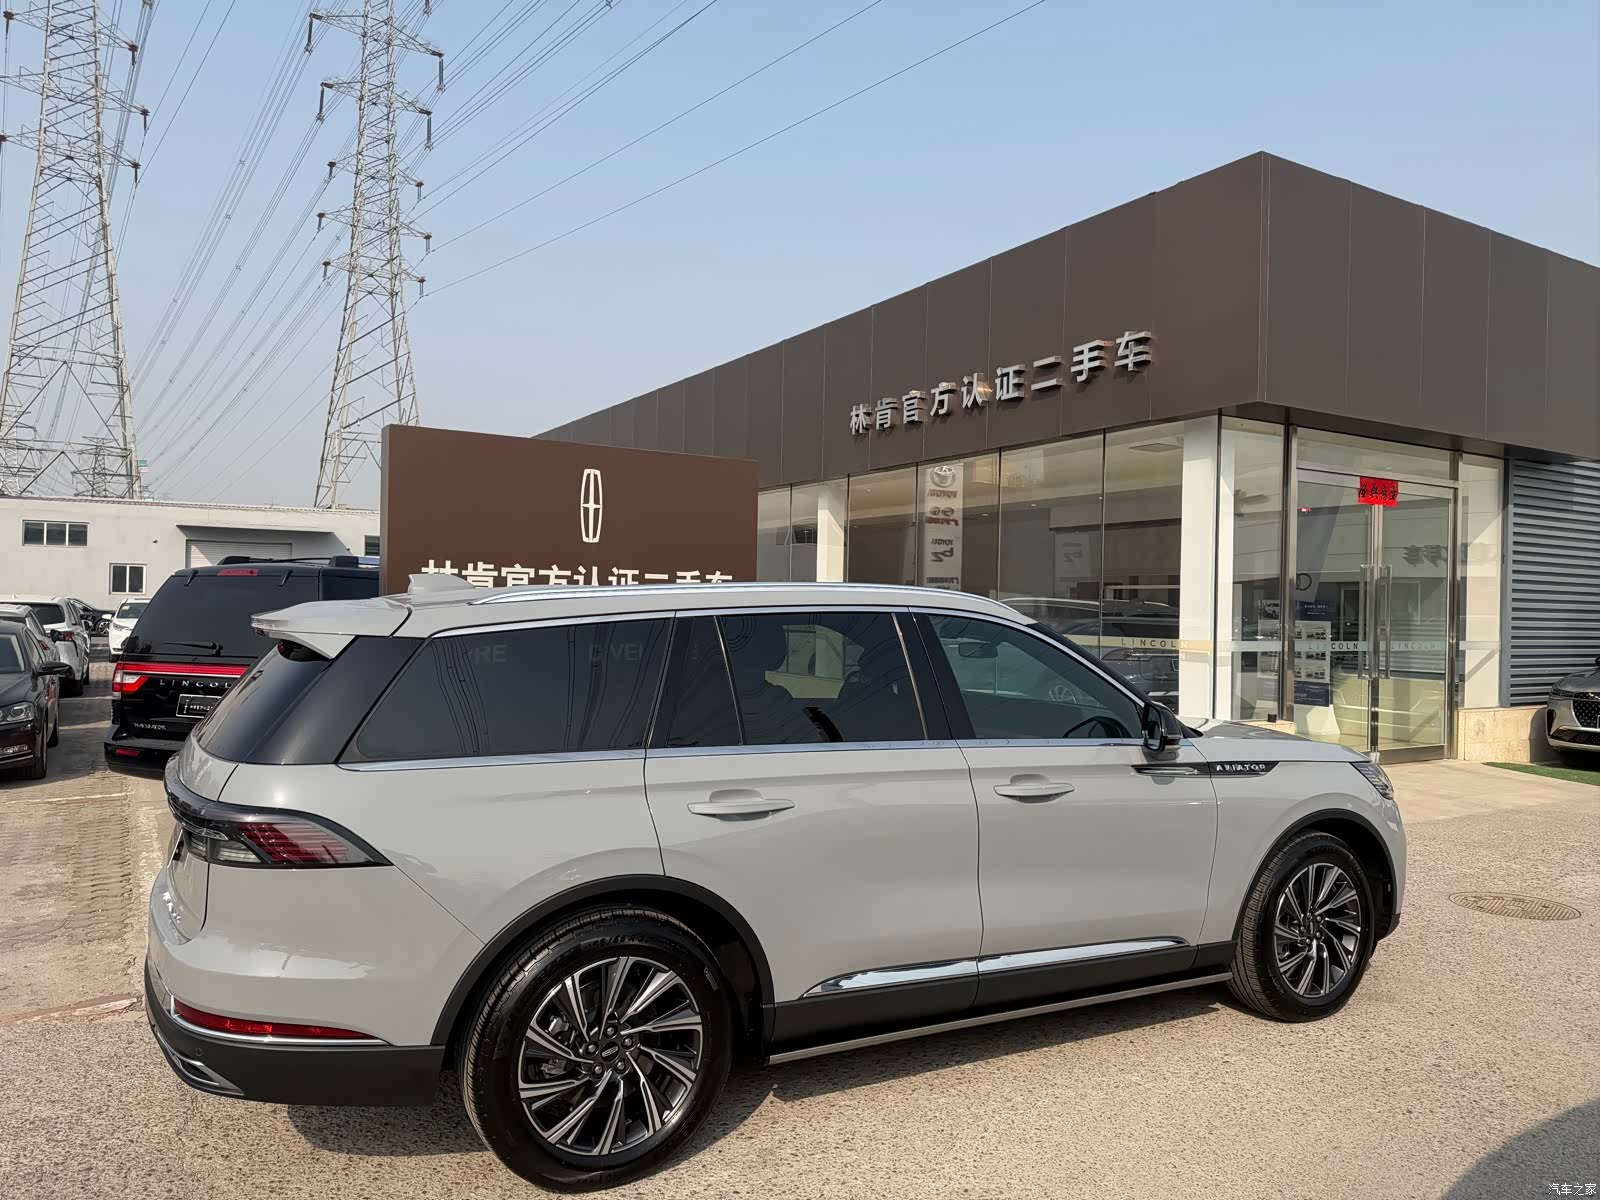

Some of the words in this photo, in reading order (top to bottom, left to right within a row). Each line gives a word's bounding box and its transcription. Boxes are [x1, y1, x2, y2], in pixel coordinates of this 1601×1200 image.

[850, 331, 1152, 435] 林肯官方认证二手车
[1120, 637, 1188, 649] LINCOLN
[1308, 642, 1359, 651] LICOLN
[159, 679, 232, 689] LINCOL
[1215, 763, 1267, 773] AVIATOR
